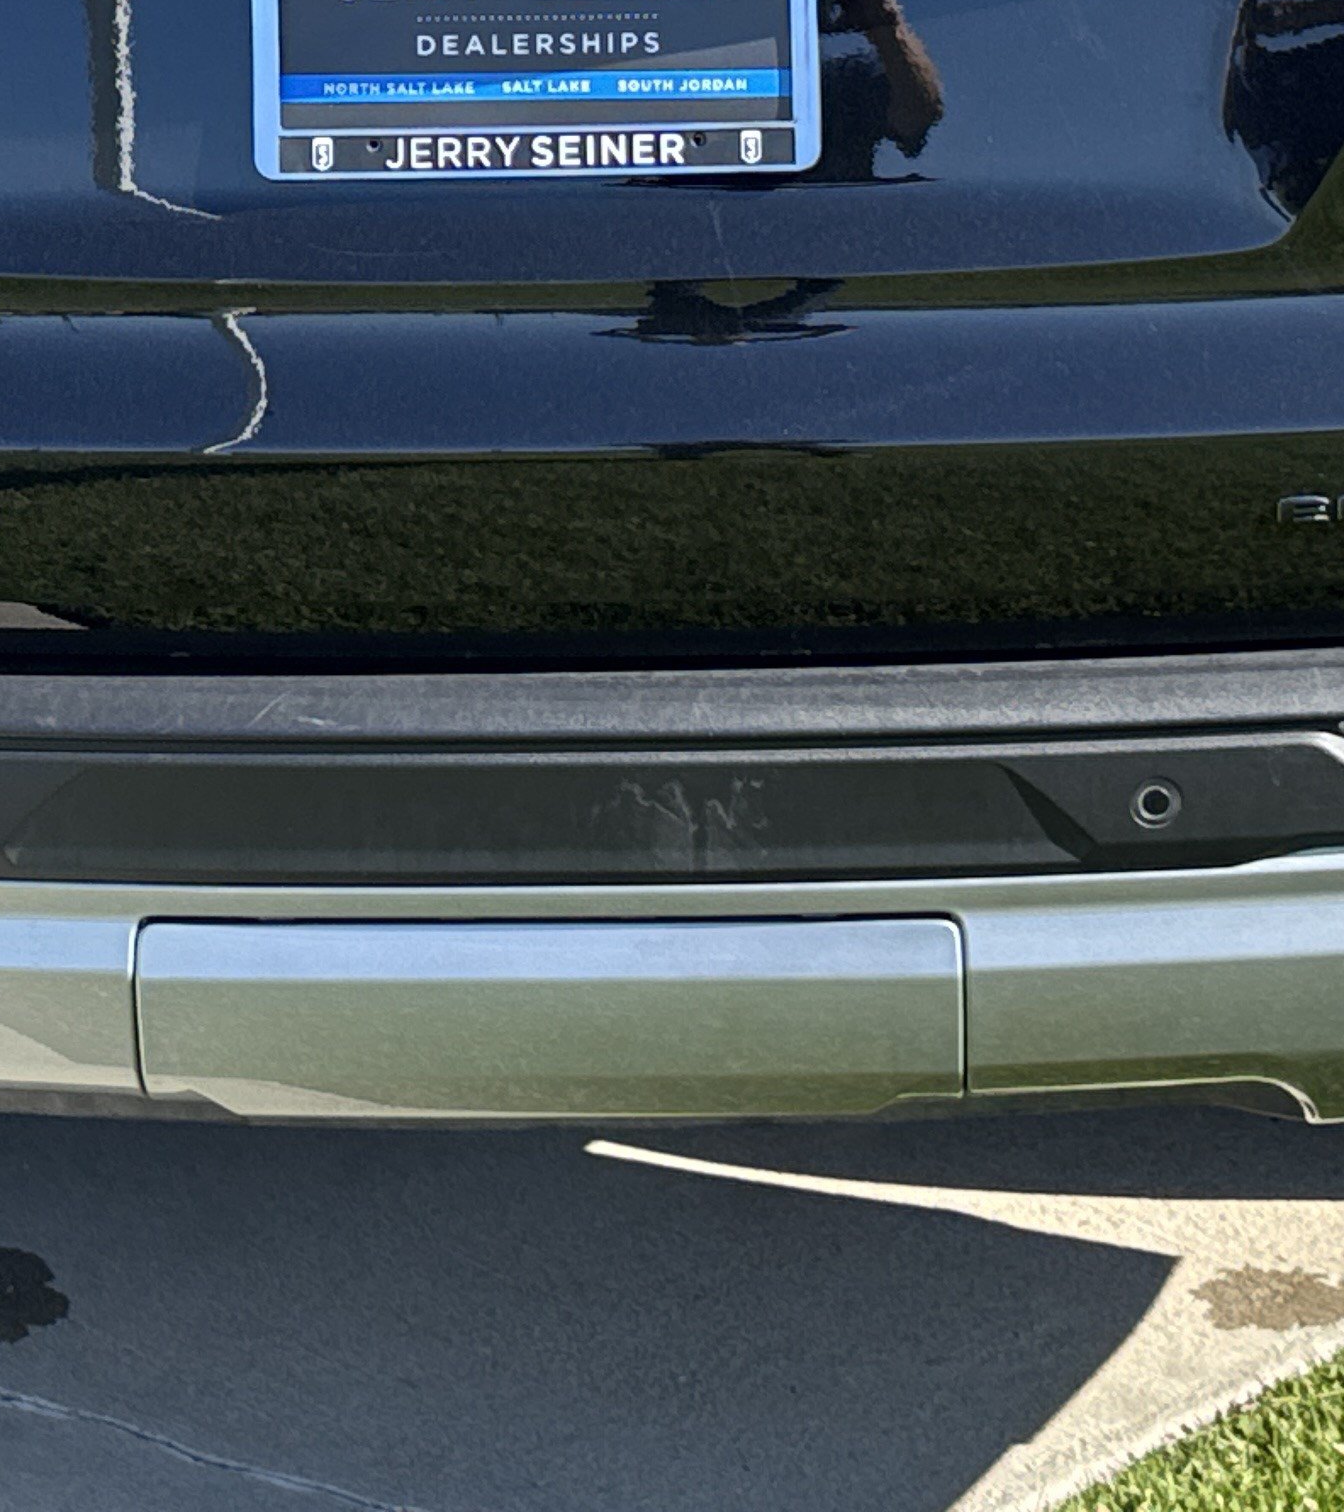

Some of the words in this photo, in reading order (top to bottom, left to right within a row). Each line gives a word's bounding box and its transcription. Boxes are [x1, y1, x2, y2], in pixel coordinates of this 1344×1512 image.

[416, 31, 661, 57] DEALERSHIPS
[323, 82, 381, 96] NORTH
[386, 82, 426, 96] SALT
[430, 81, 476, 95] LAKE
[501, 78, 543, 94] SALT
[547, 79, 591, 93] LAKE
[617, 78, 674, 92] SOUTH
[678, 77, 748, 92] JORDAN
[385, 136, 521, 170] JERRY
[530, 133, 686, 167] SEINER
